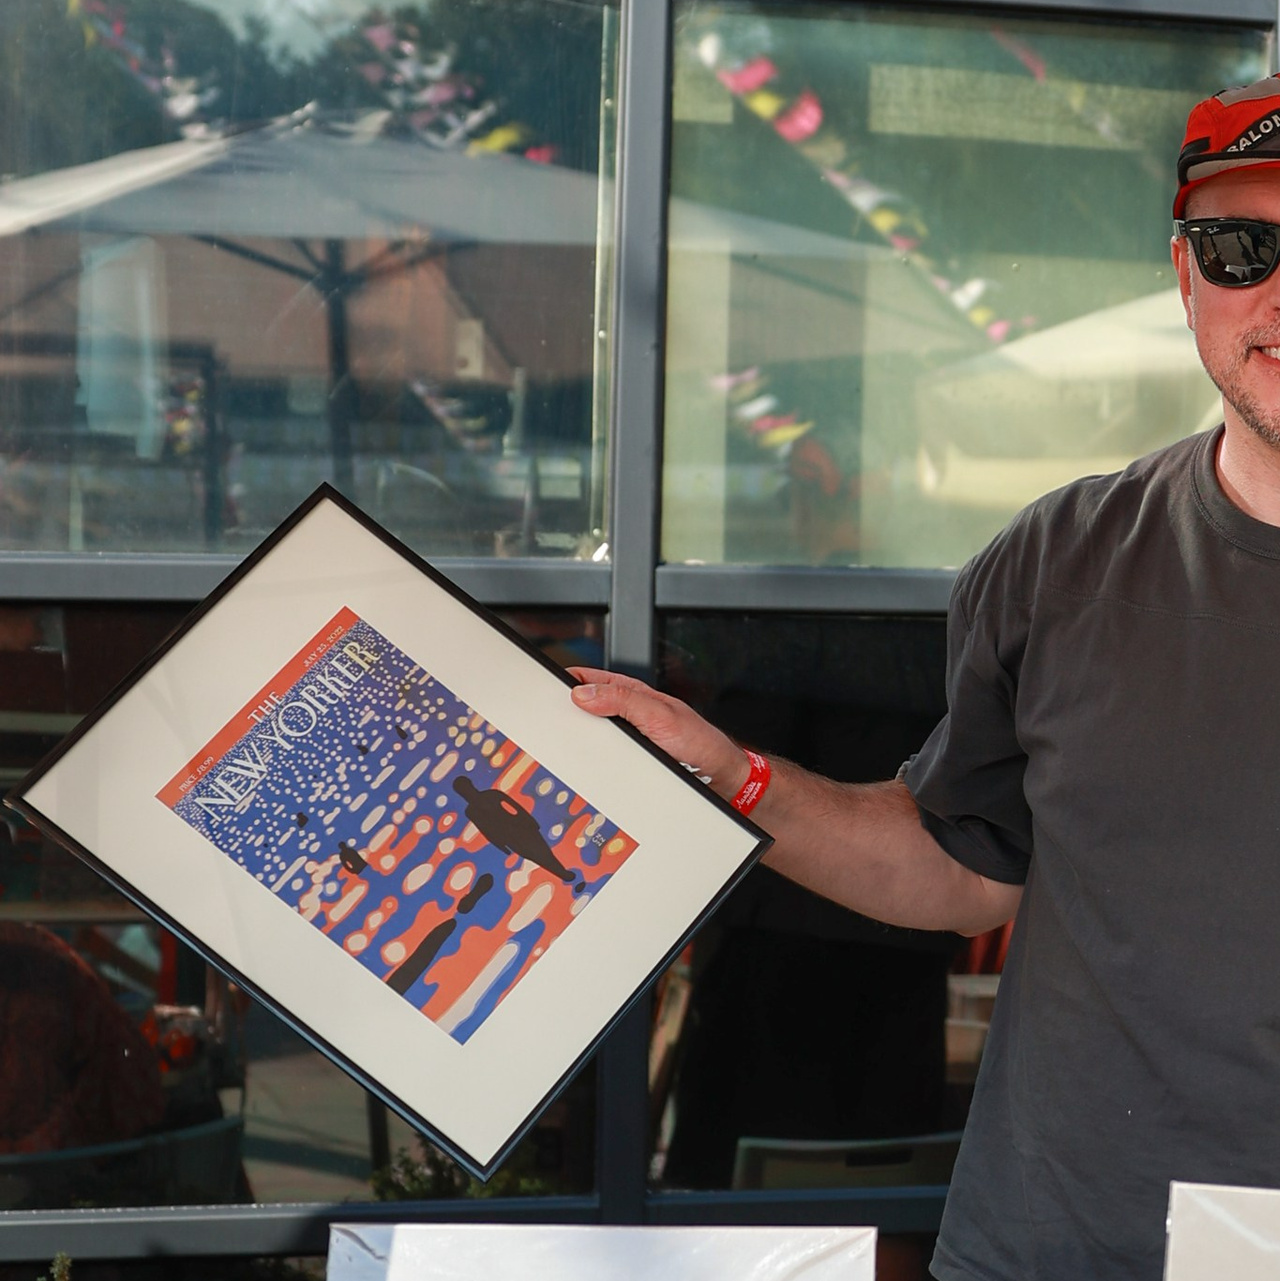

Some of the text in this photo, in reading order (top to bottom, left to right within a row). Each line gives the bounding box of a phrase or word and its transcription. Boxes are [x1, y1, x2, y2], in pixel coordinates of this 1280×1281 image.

[194, 640, 381, 822] NEW YORKER
[247, 691, 286, 725] THE
